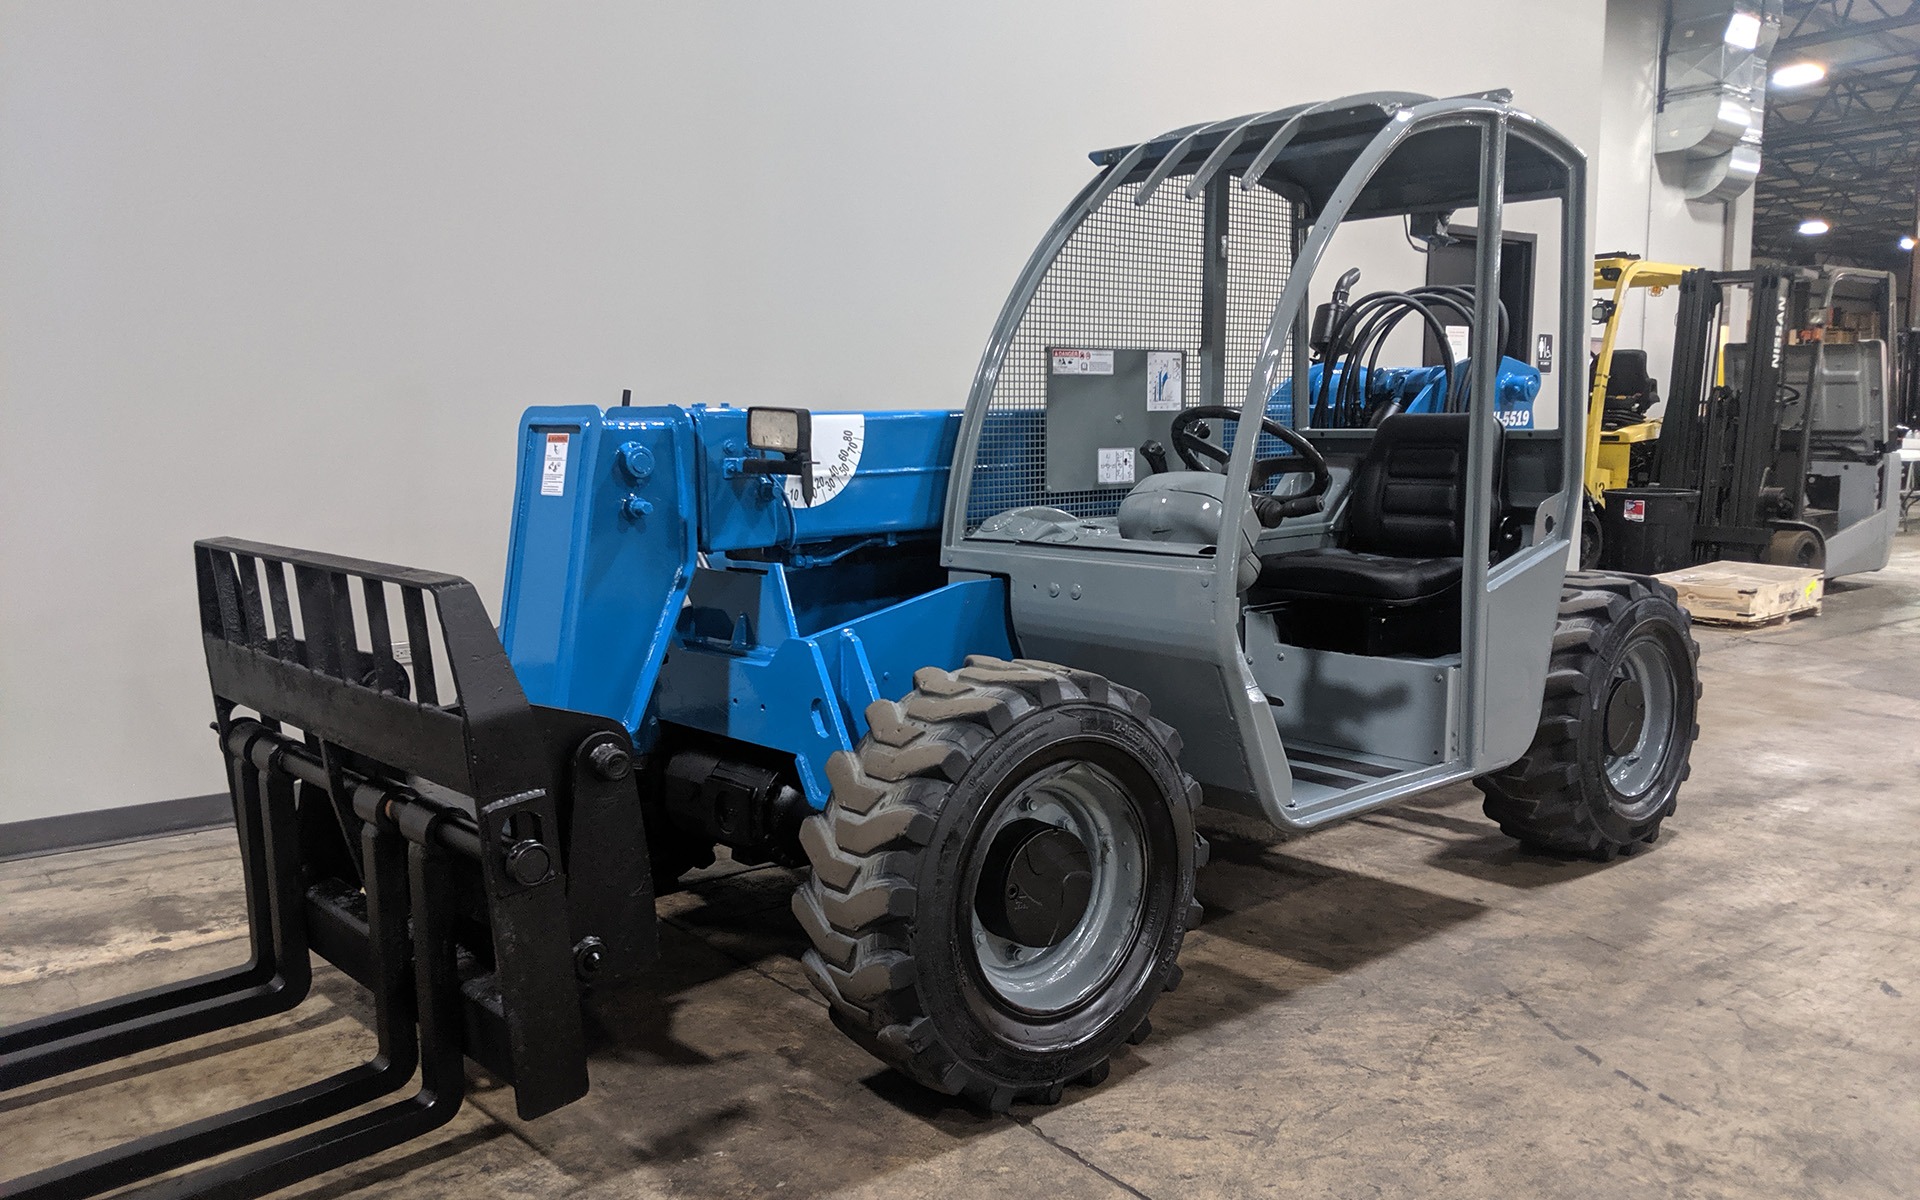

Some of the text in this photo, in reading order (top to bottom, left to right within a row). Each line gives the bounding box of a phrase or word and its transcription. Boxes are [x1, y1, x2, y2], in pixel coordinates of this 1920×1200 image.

[1771, 296, 1786, 368] NISSAN
[843, 430, 853, 442] 80
[847, 442, 858, 454] 70
[838, 449, 849, 462] 60
[828, 465, 839, 478] 40
[839, 464, 849, 477] 50
[814, 476, 825, 489] 20
[825, 478, 836, 492] 30
